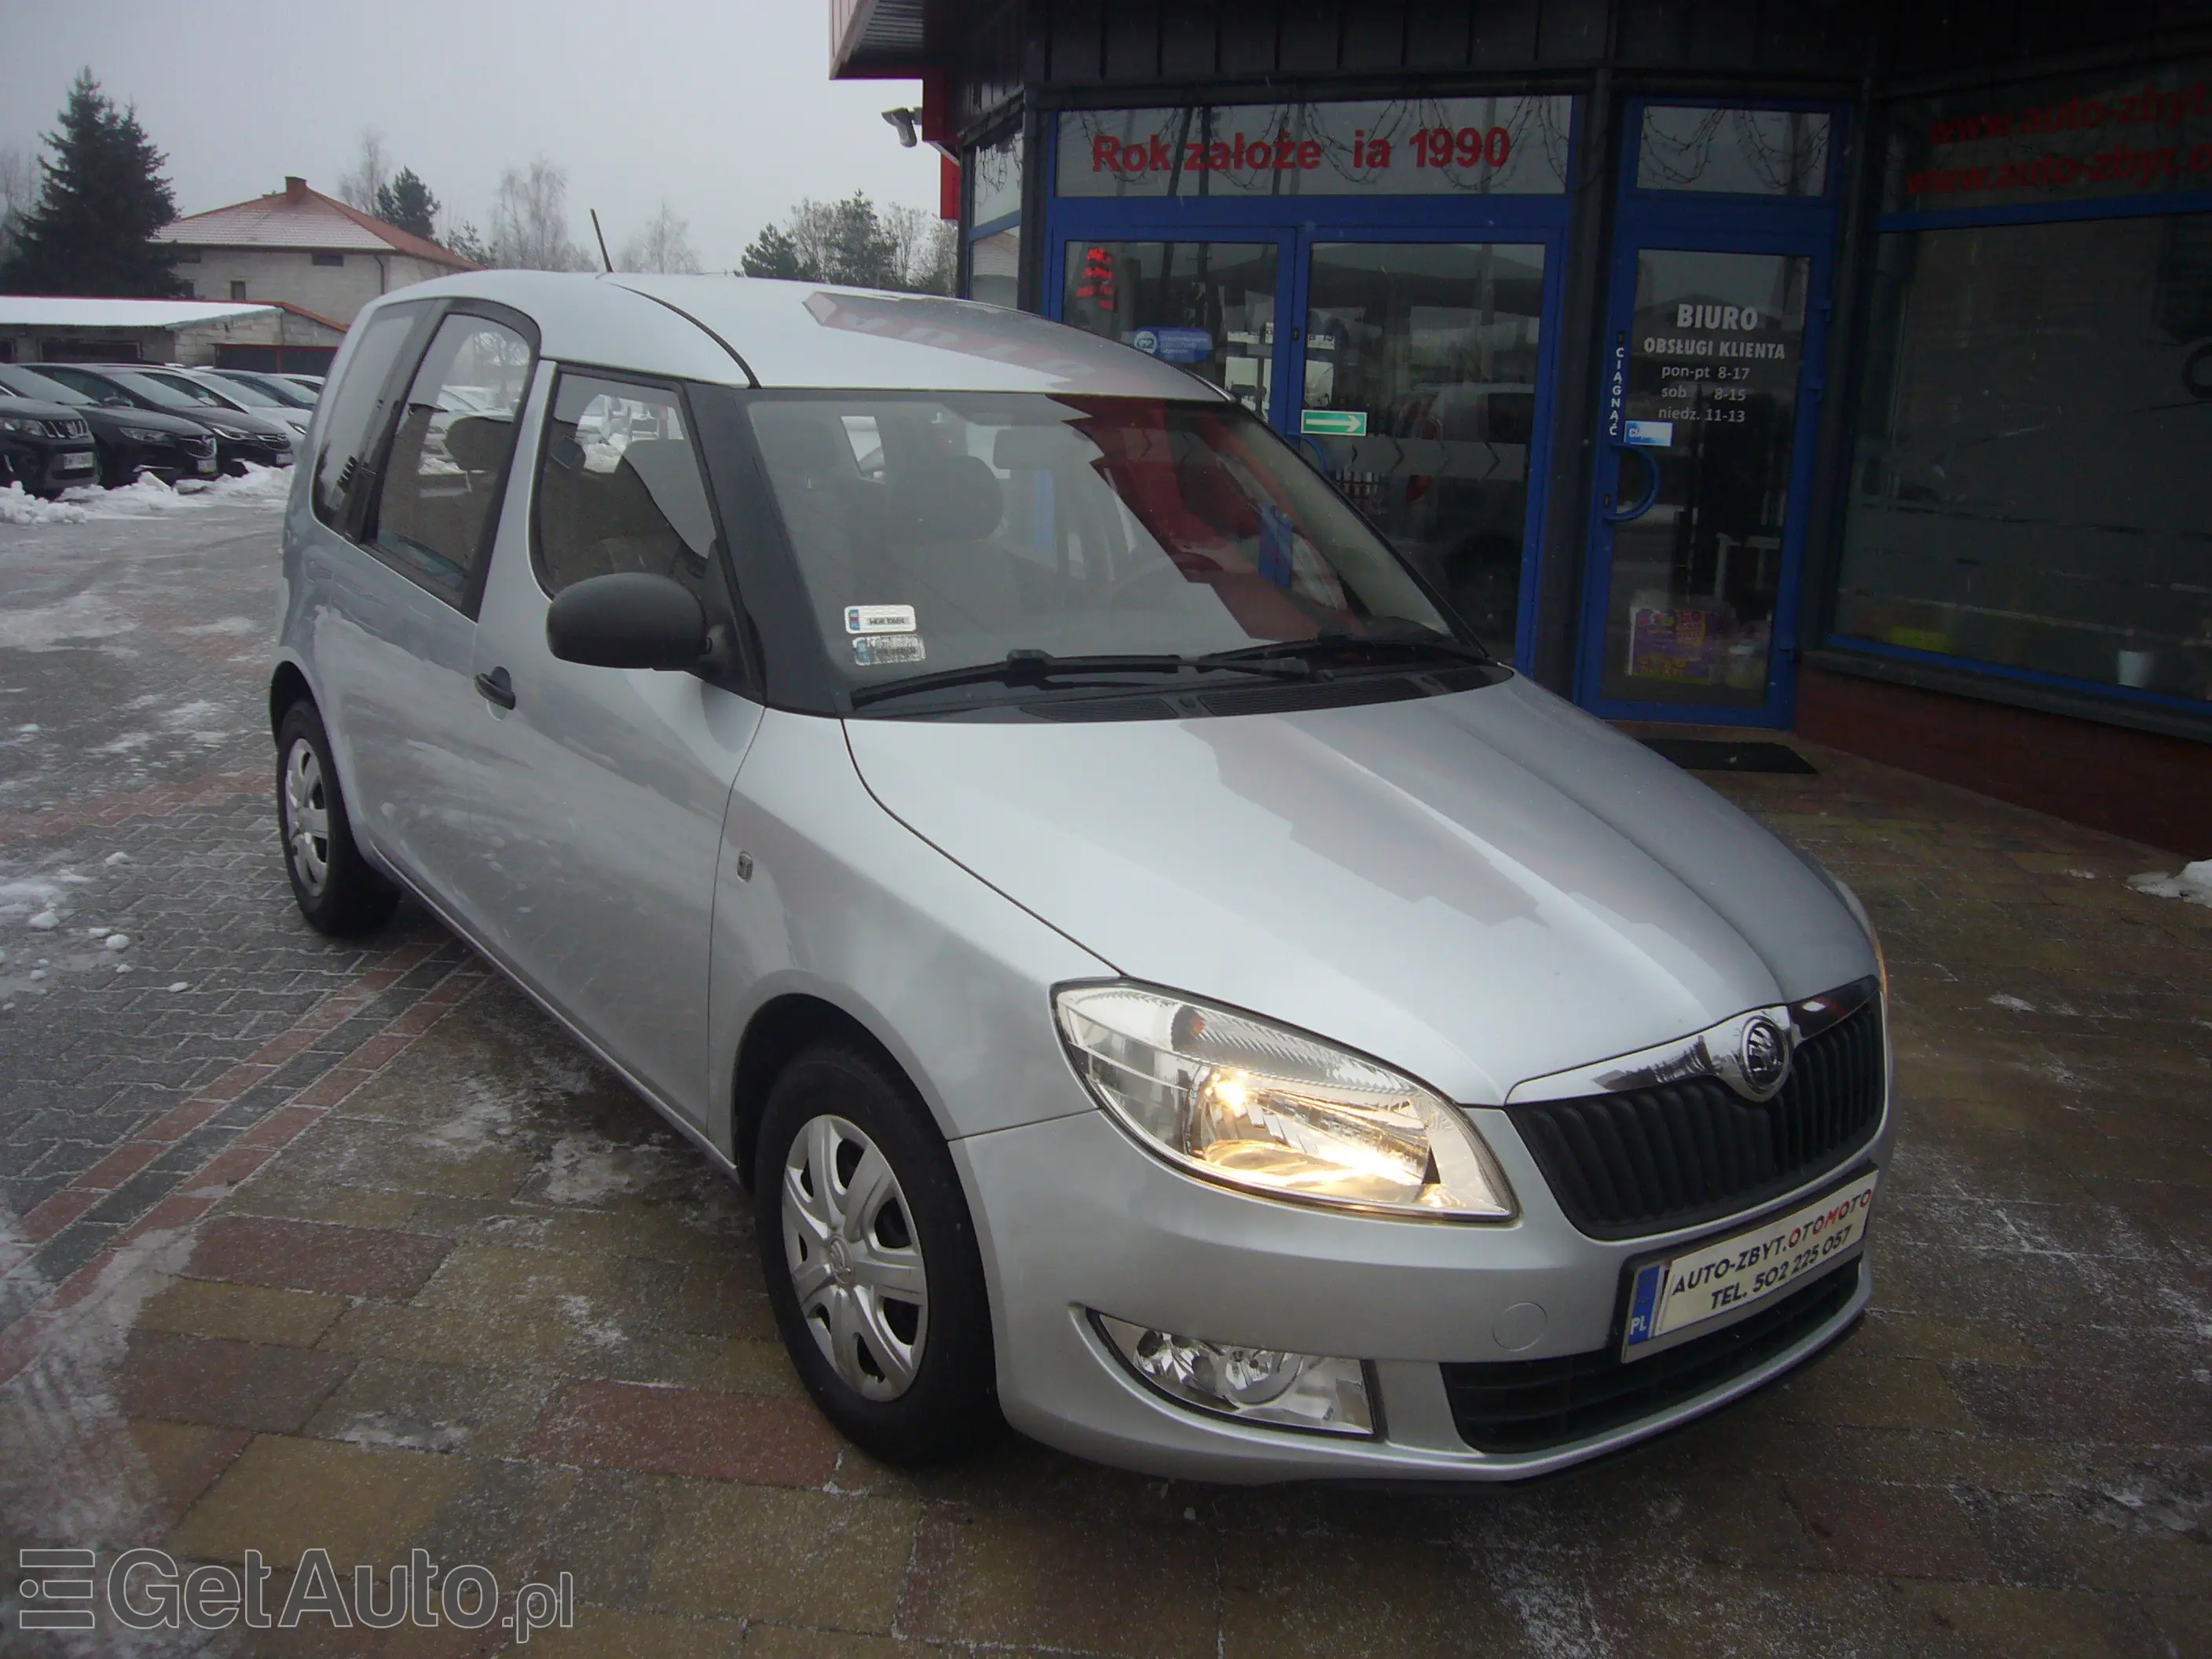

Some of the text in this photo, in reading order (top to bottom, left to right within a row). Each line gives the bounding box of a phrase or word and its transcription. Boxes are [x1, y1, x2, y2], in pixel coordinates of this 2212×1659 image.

[1092, 134, 1171, 172] Rok
[1409, 126, 1511, 168] 1990
[1676, 304, 1758, 331] BIURO
[1643, 337, 1785, 359] OBSŁUGI KLIENTA
[1661, 364, 1750, 380] pon-pt 8-17
[1661, 386, 1746, 401] sob 8-15
[1659, 407, 1745, 423] niedz. 11-13
[1672, 1188, 1872, 1295] AUTO-ZBYT.OTOMOTO
[1712, 1223, 1852, 1309] TEL. 502 225 057
[1630, 1317, 1648, 1335] PL
